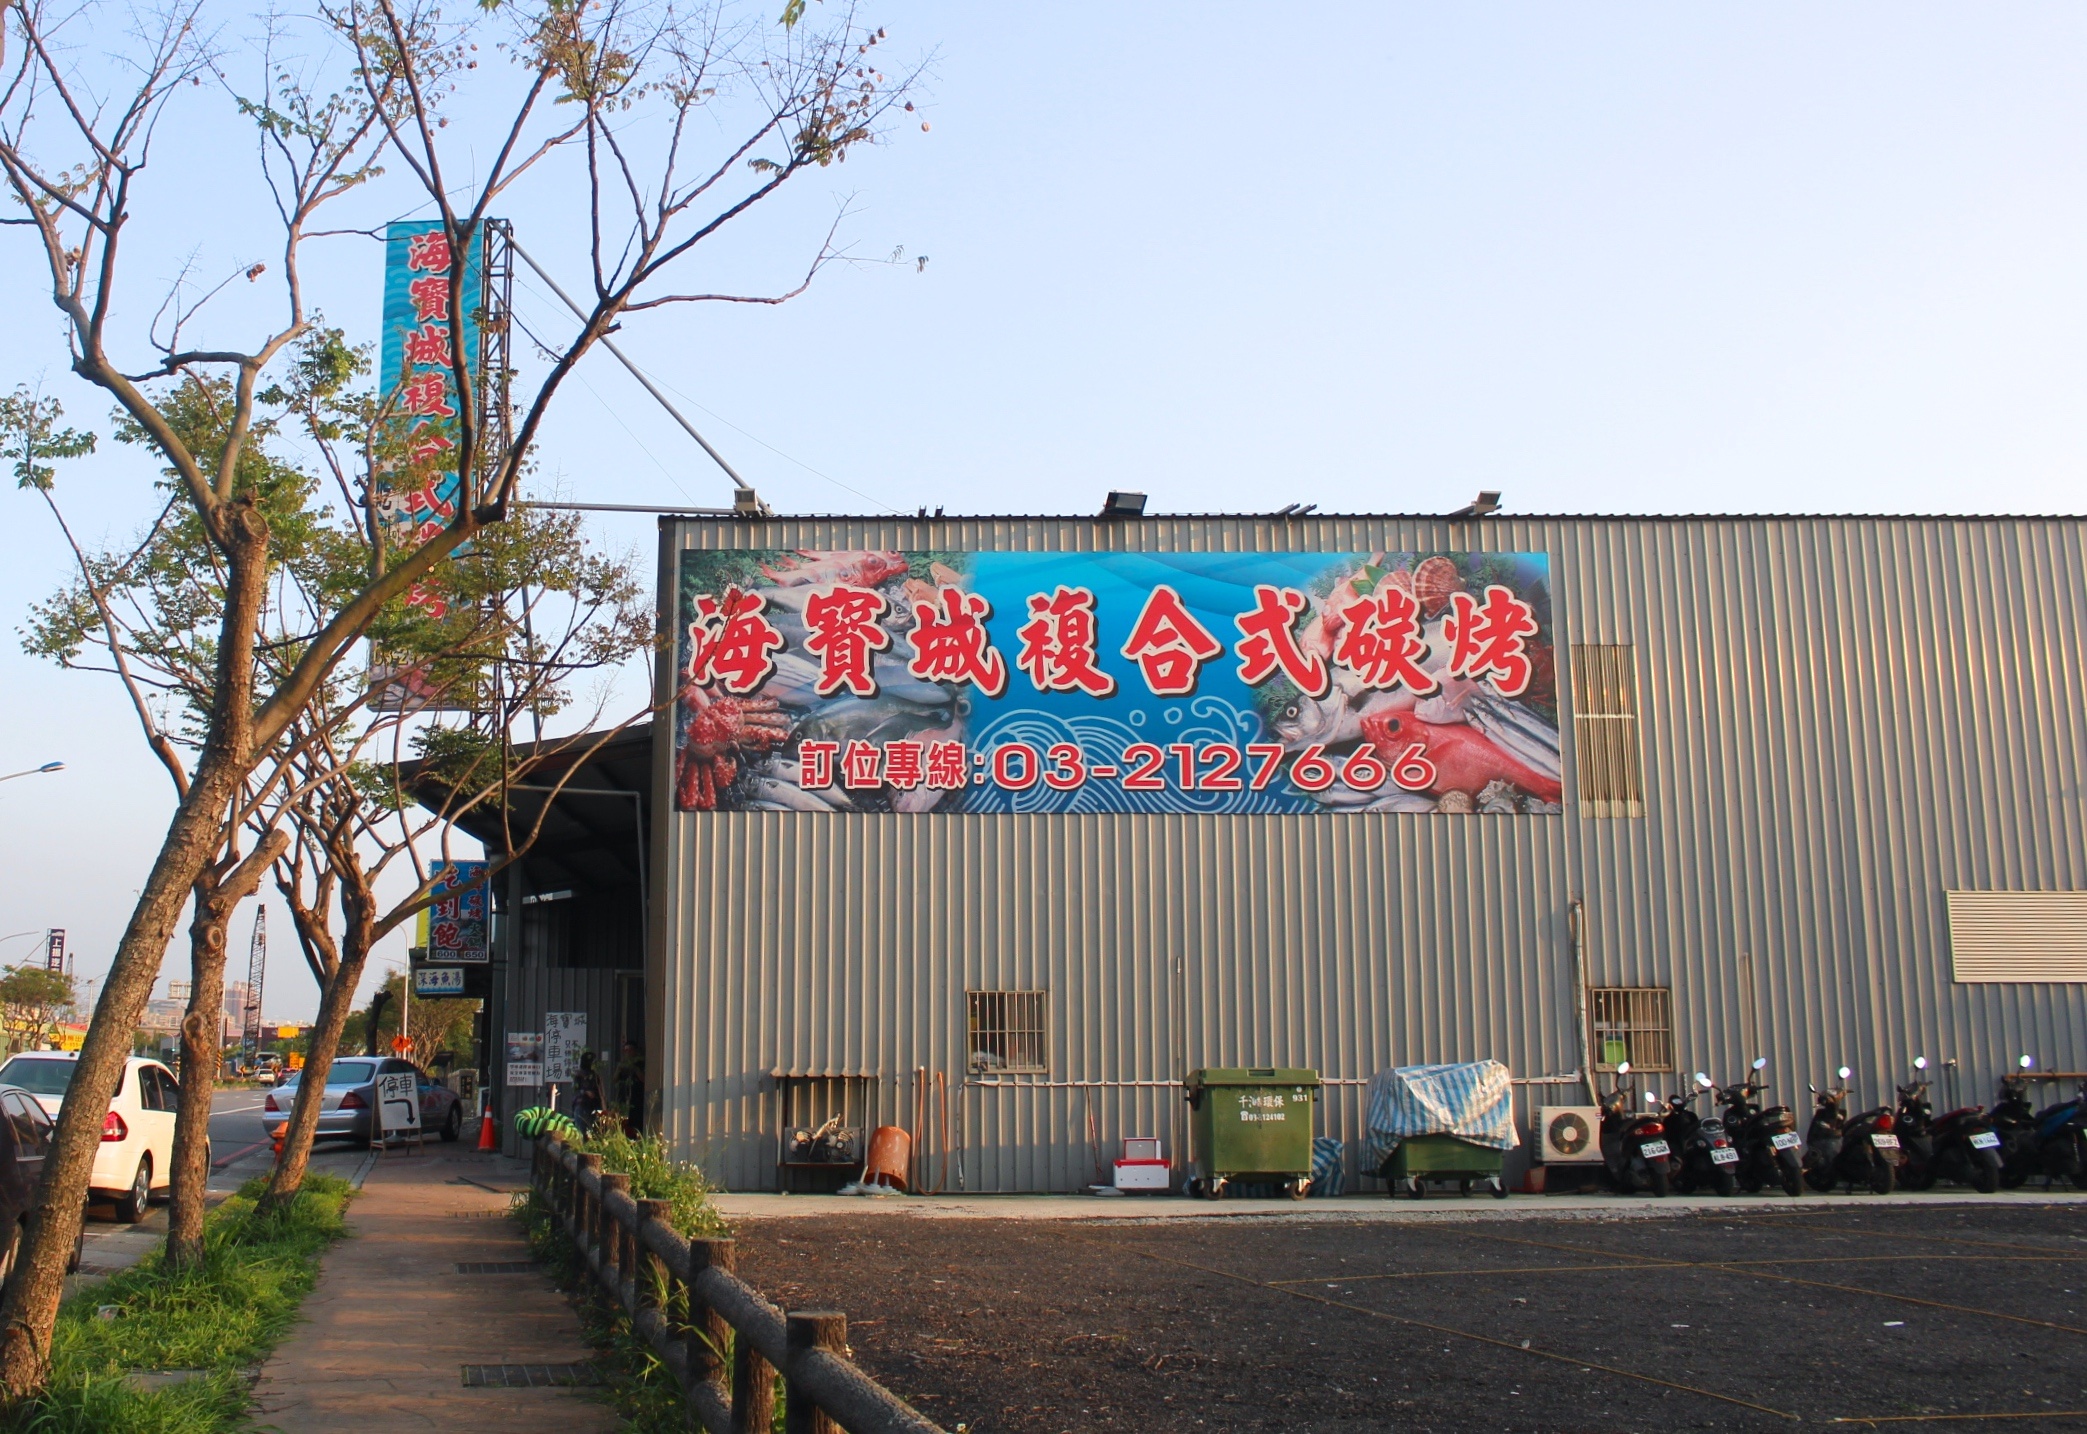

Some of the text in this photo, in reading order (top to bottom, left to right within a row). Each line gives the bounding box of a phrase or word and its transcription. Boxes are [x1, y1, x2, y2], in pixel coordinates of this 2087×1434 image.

[689, 585, 1538, 698] 海寶城複合式碳烤
[417, 971, 461, 986] 深海魚湯
[545, 1029, 563, 1080] 停車場
[379, 1074, 414, 1098] 停車
[1292, 1094, 1308, 1102] 931
